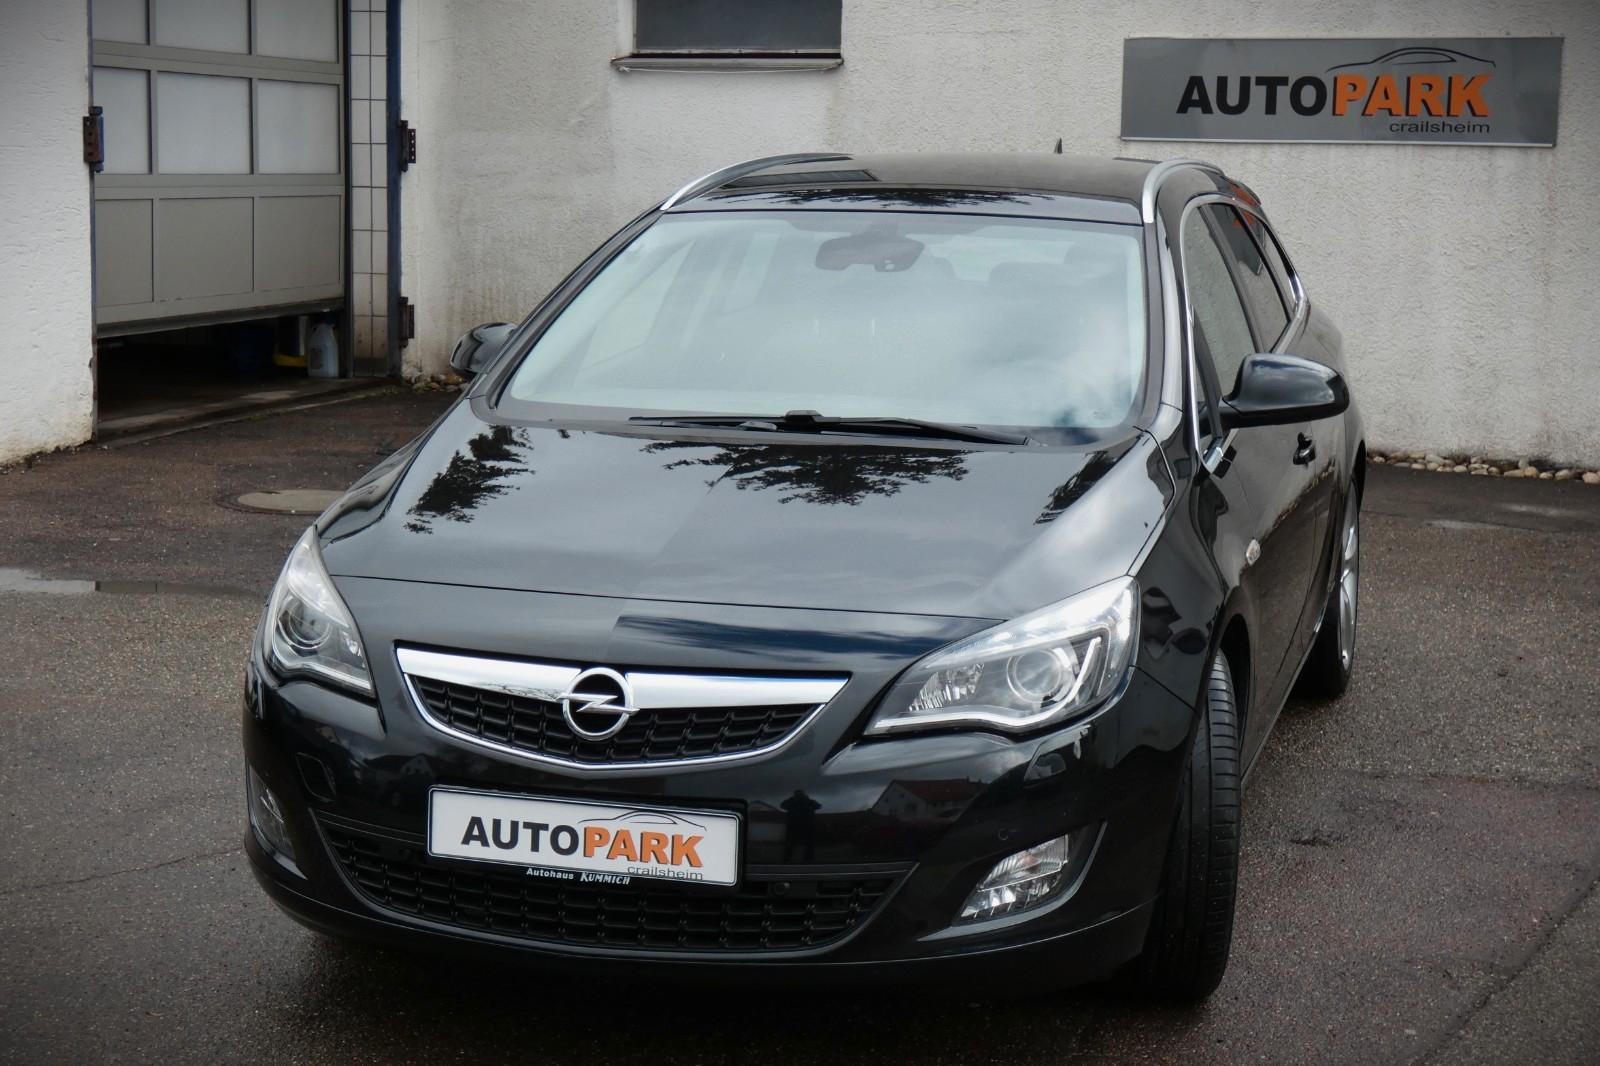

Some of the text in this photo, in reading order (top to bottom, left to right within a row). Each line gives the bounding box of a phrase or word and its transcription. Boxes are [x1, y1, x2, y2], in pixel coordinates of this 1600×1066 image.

[1176, 73, 1495, 118] AUTOPARK
[1389, 120, 1490, 134] crailsheim
[461, 815, 704, 868] AUTOPARK
[526, 867, 574, 880] Autohaus
[627, 865, 703, 881] crailsheim
